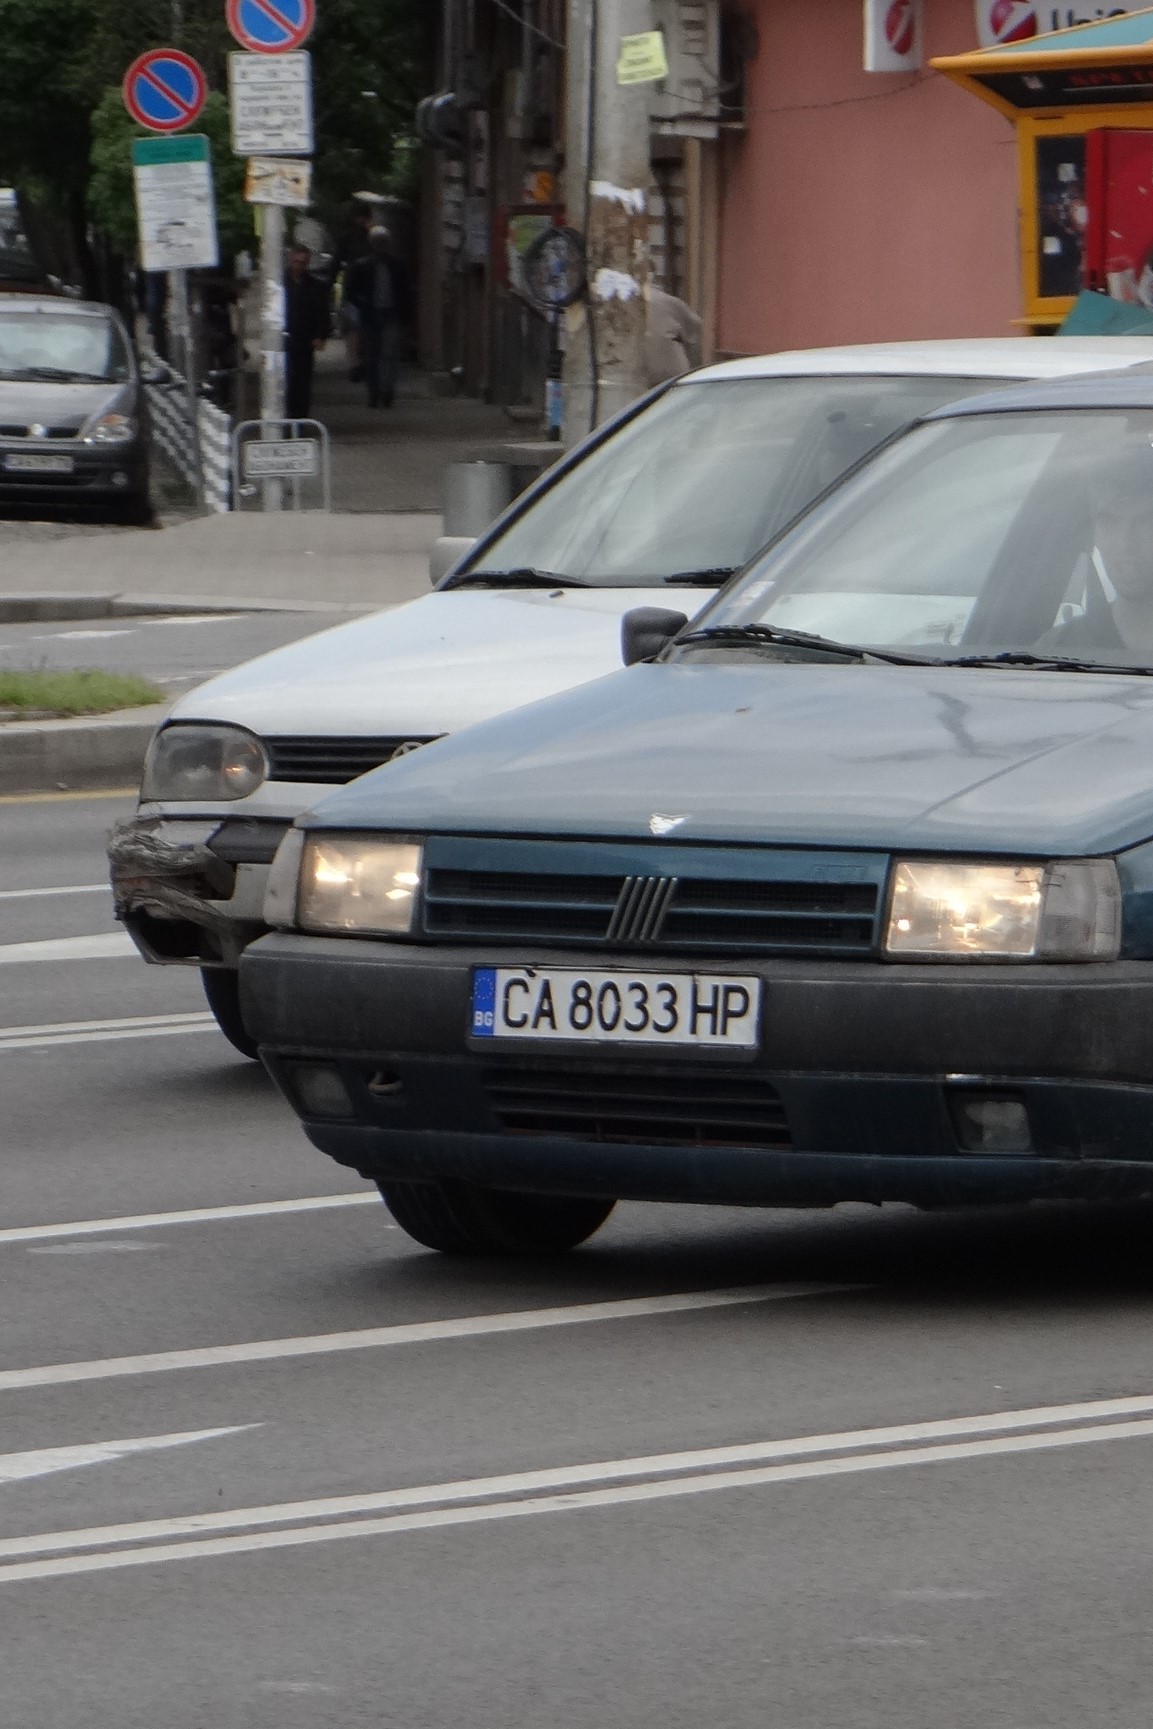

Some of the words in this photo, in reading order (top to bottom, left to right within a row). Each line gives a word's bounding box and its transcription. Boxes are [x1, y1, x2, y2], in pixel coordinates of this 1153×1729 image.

[473, 1010, 493, 1027] BG
[503, 976, 558, 1031] CA
[568, 978, 679, 1033] 8033
[690, 980, 750, 1035] HP
